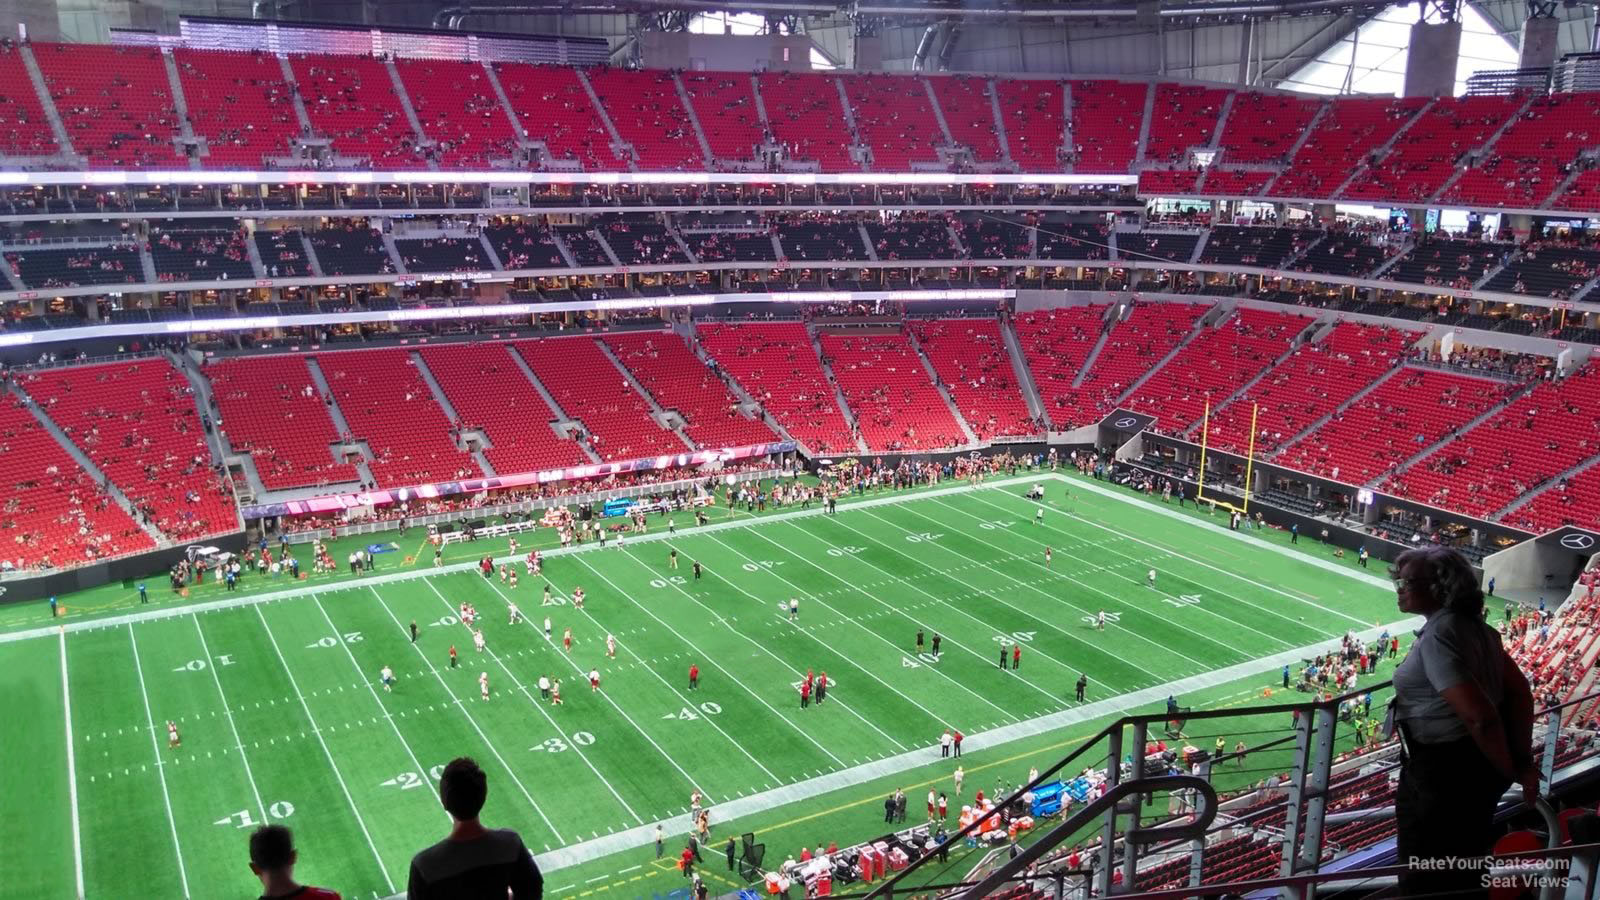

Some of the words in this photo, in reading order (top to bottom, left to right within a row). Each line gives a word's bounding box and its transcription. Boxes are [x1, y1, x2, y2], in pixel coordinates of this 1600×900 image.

[421, 273, 467, 281] Mercedes-Benz
[467, 272, 492, 280] Stadium
[679, 702, 722, 721] 40
[543, 731, 596, 753] 30
[231, 801, 295, 828] 10
